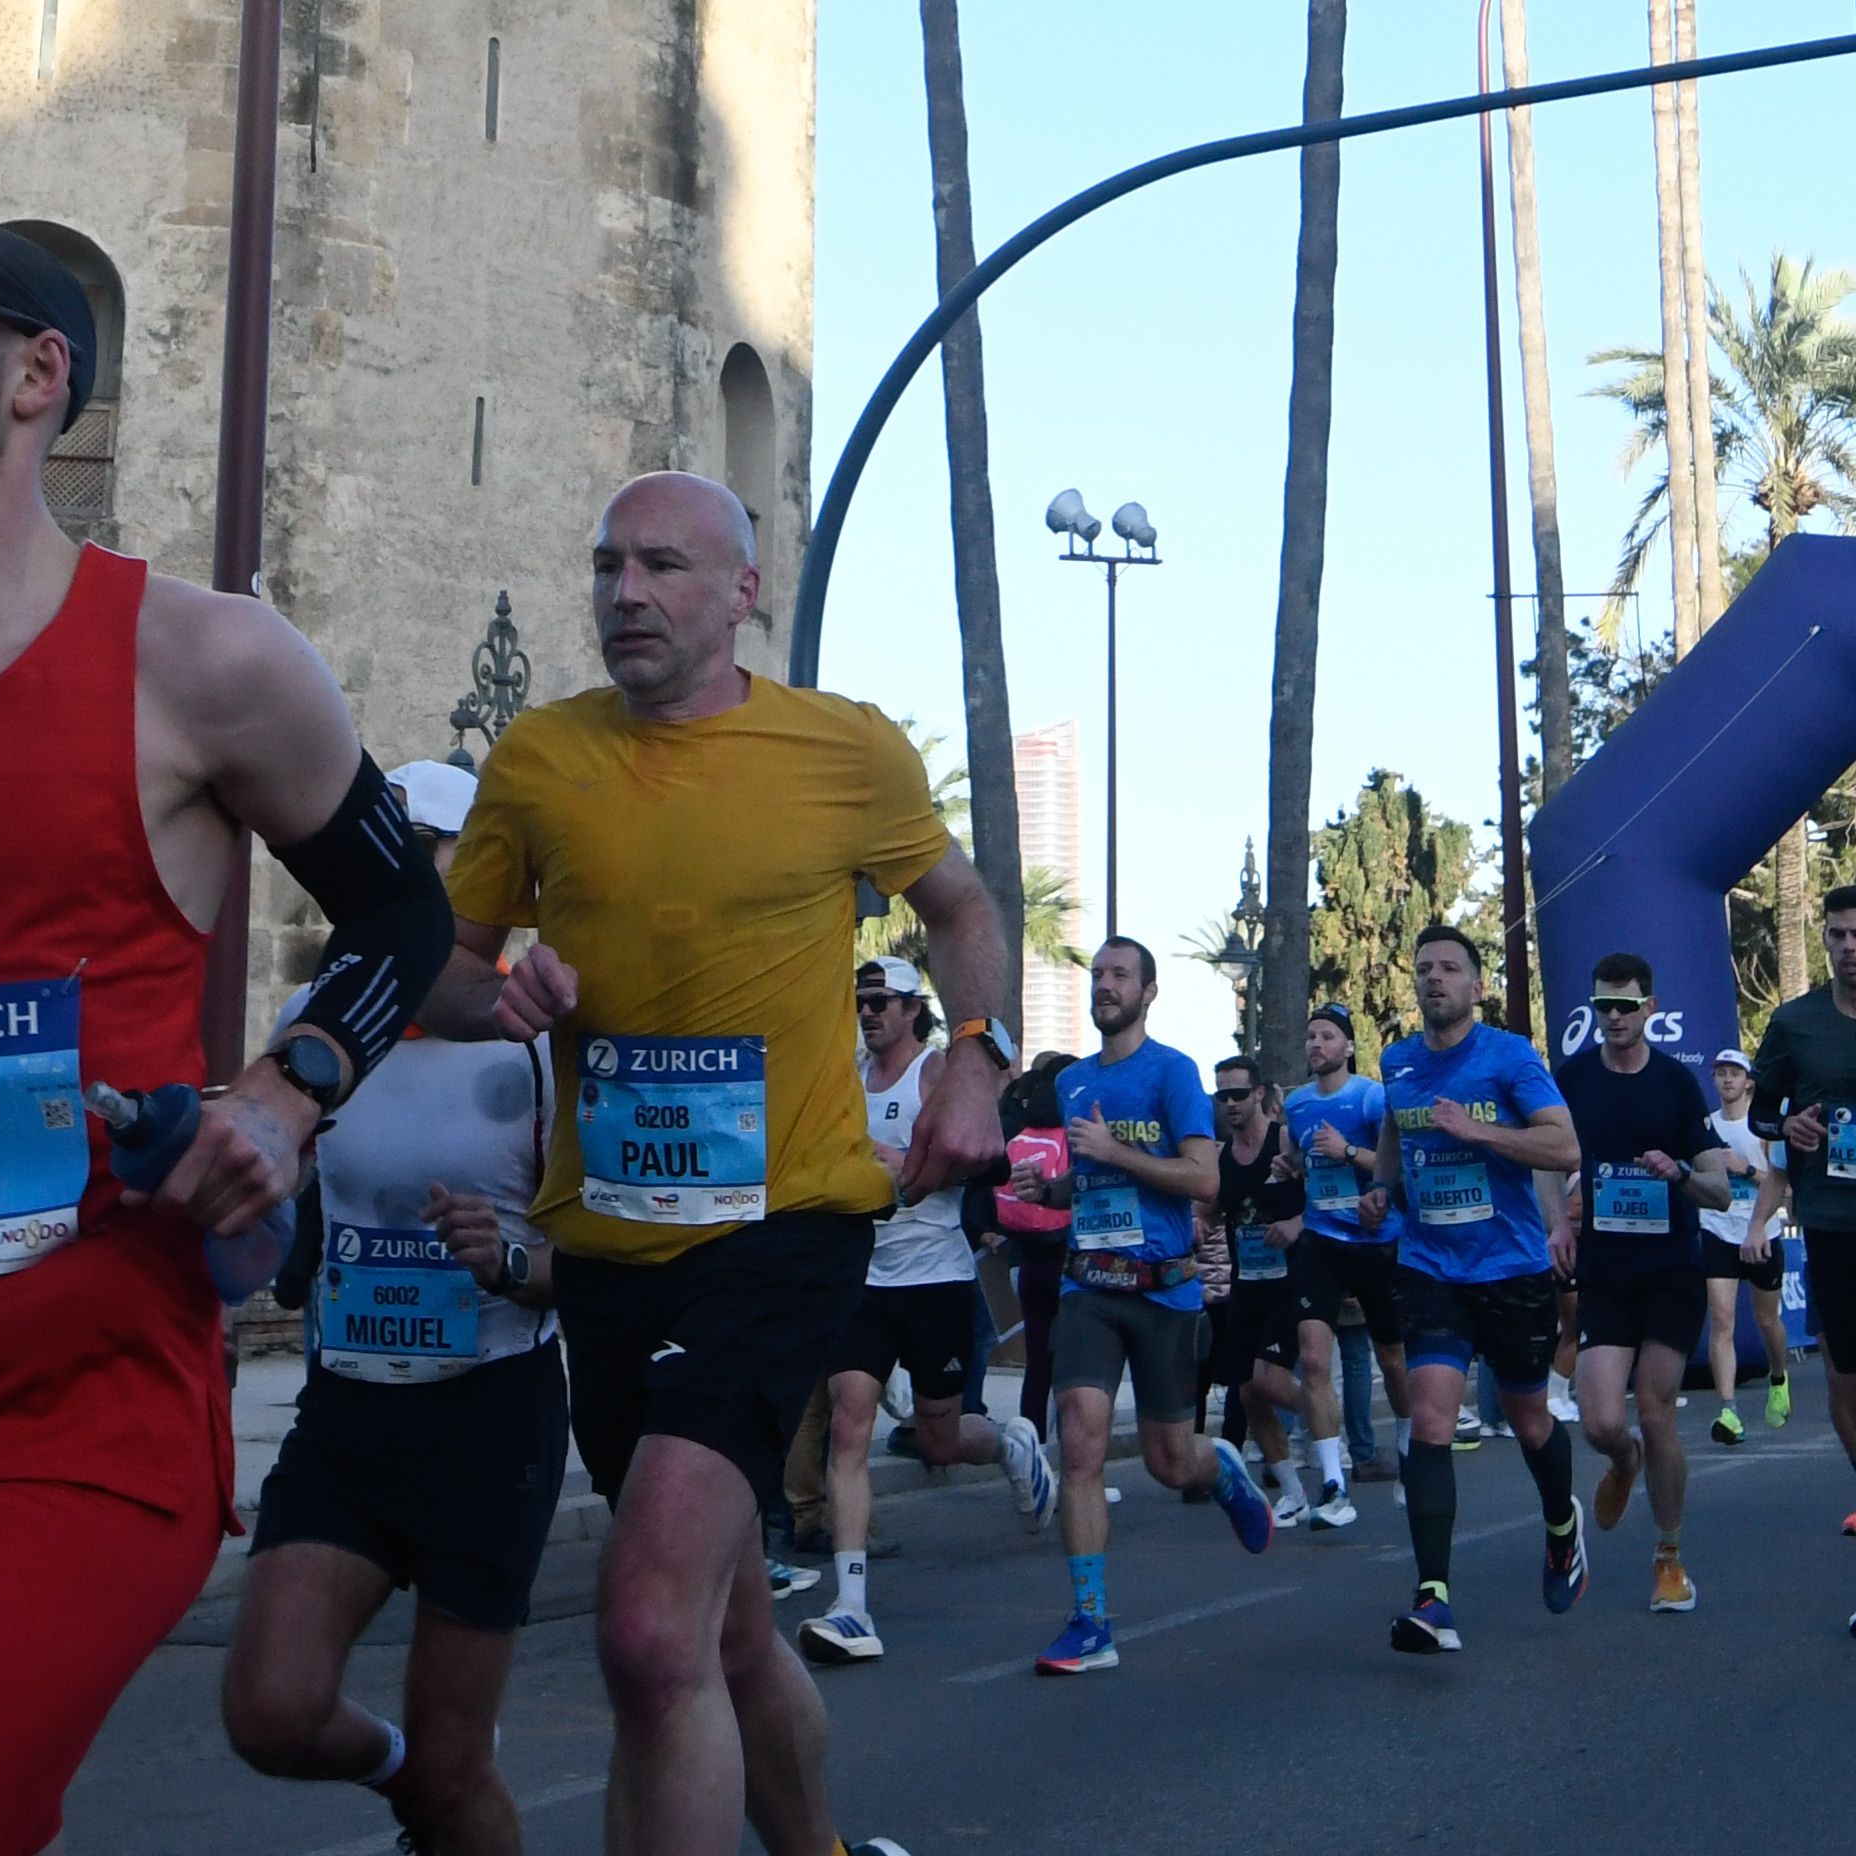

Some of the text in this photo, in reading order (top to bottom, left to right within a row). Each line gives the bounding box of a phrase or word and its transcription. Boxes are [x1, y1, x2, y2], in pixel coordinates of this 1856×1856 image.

[630, 1048, 739, 1073] ZURICH
[1681, 1051, 1705, 1064] body
[634, 1104, 690, 1129] 6208
[621, 1140, 709, 1178] PAUL
[1430, 1151, 1474, 1163] ZURICH
[1617, 1166, 1653, 1177] ZURIC
[1420, 1187, 1482, 1206] ALBERTO
[1077, 1211, 1132, 1230] RICARDO
[373, 1286, 420, 1306] 6002
[346, 1314, 451, 1349] MIGUEL
